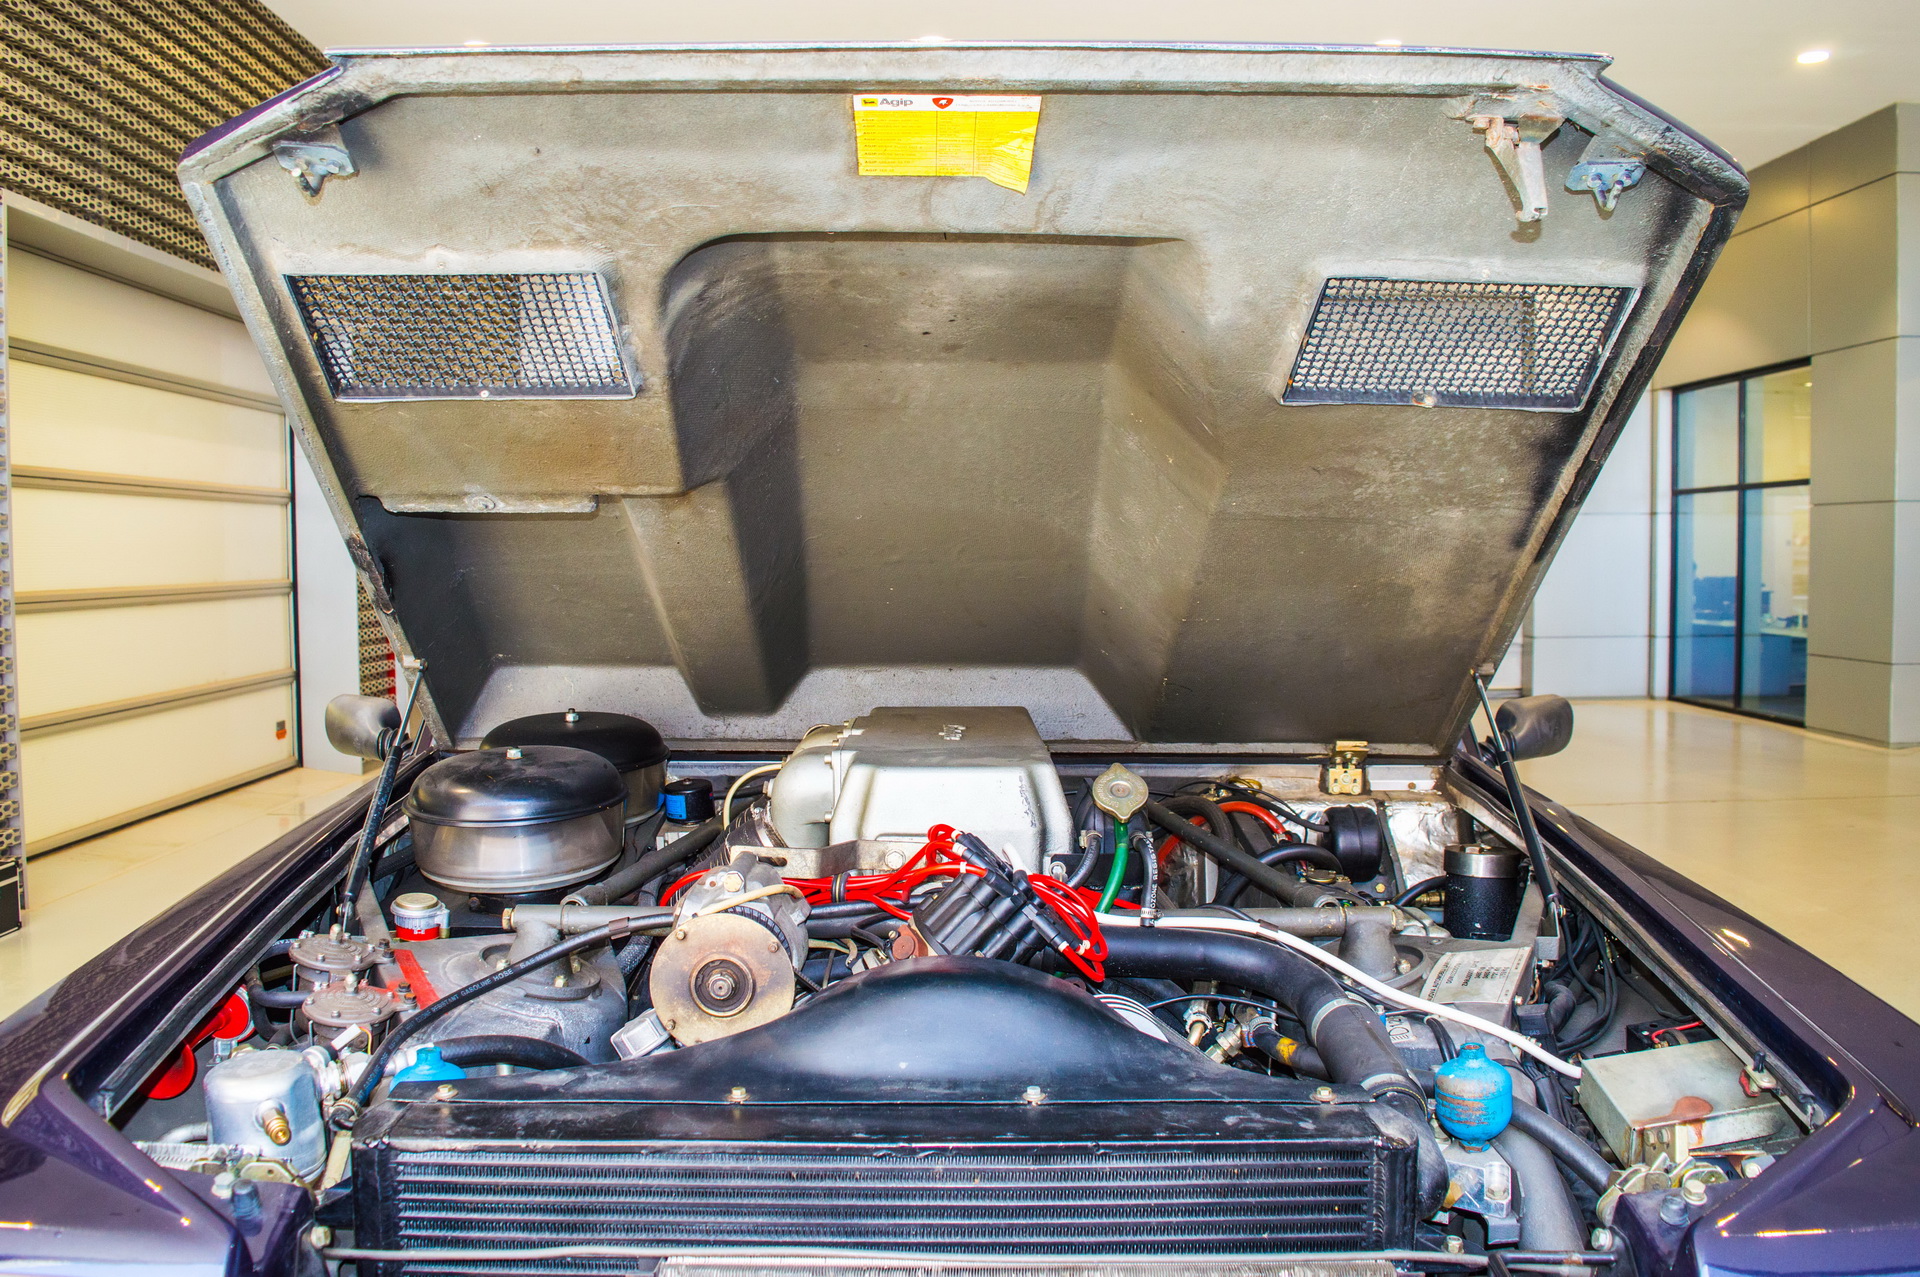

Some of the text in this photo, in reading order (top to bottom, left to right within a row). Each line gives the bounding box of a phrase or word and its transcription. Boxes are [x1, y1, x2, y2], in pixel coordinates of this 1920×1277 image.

[880, 98, 913, 107] Agip
[430, 994, 460, 1013] RESISTANT
[460, 978, 493, 997] GASOLINE
[492, 968, 514, 982] HOSE
